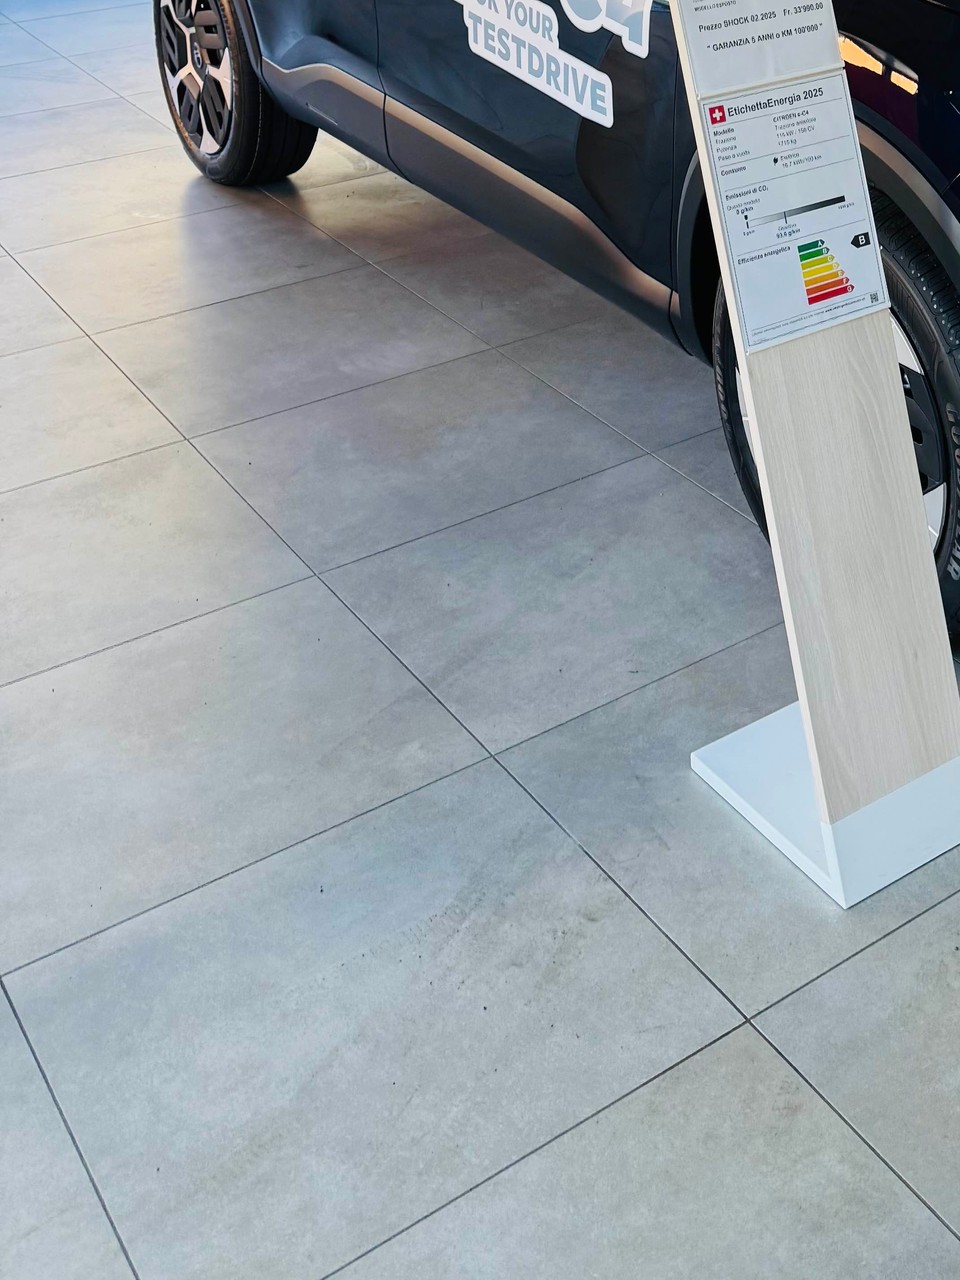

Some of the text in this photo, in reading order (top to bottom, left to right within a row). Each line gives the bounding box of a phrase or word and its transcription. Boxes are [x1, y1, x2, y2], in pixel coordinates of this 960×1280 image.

[698, 22, 722, 32] Prezzo
[724, 15, 750, 28] SHOCK
[783, 8, 793, 16] Fr.
[794, 2, 824, 14] 33'990.00
[712, 38, 750, 52] GARANZIA
[757, 33, 774, 42] ANNI
[781, 28, 793, 38] KM
[794, 24, 819, 35] 100'000
[467, 11, 608, 116] TESTDRIVE
[727, 87, 824, 118] EtichettaEnergia 2025
[713, 128, 735, 136] Modello
[726, 190, 752, 201] Emissioni
[858, 235, 866, 245] B
